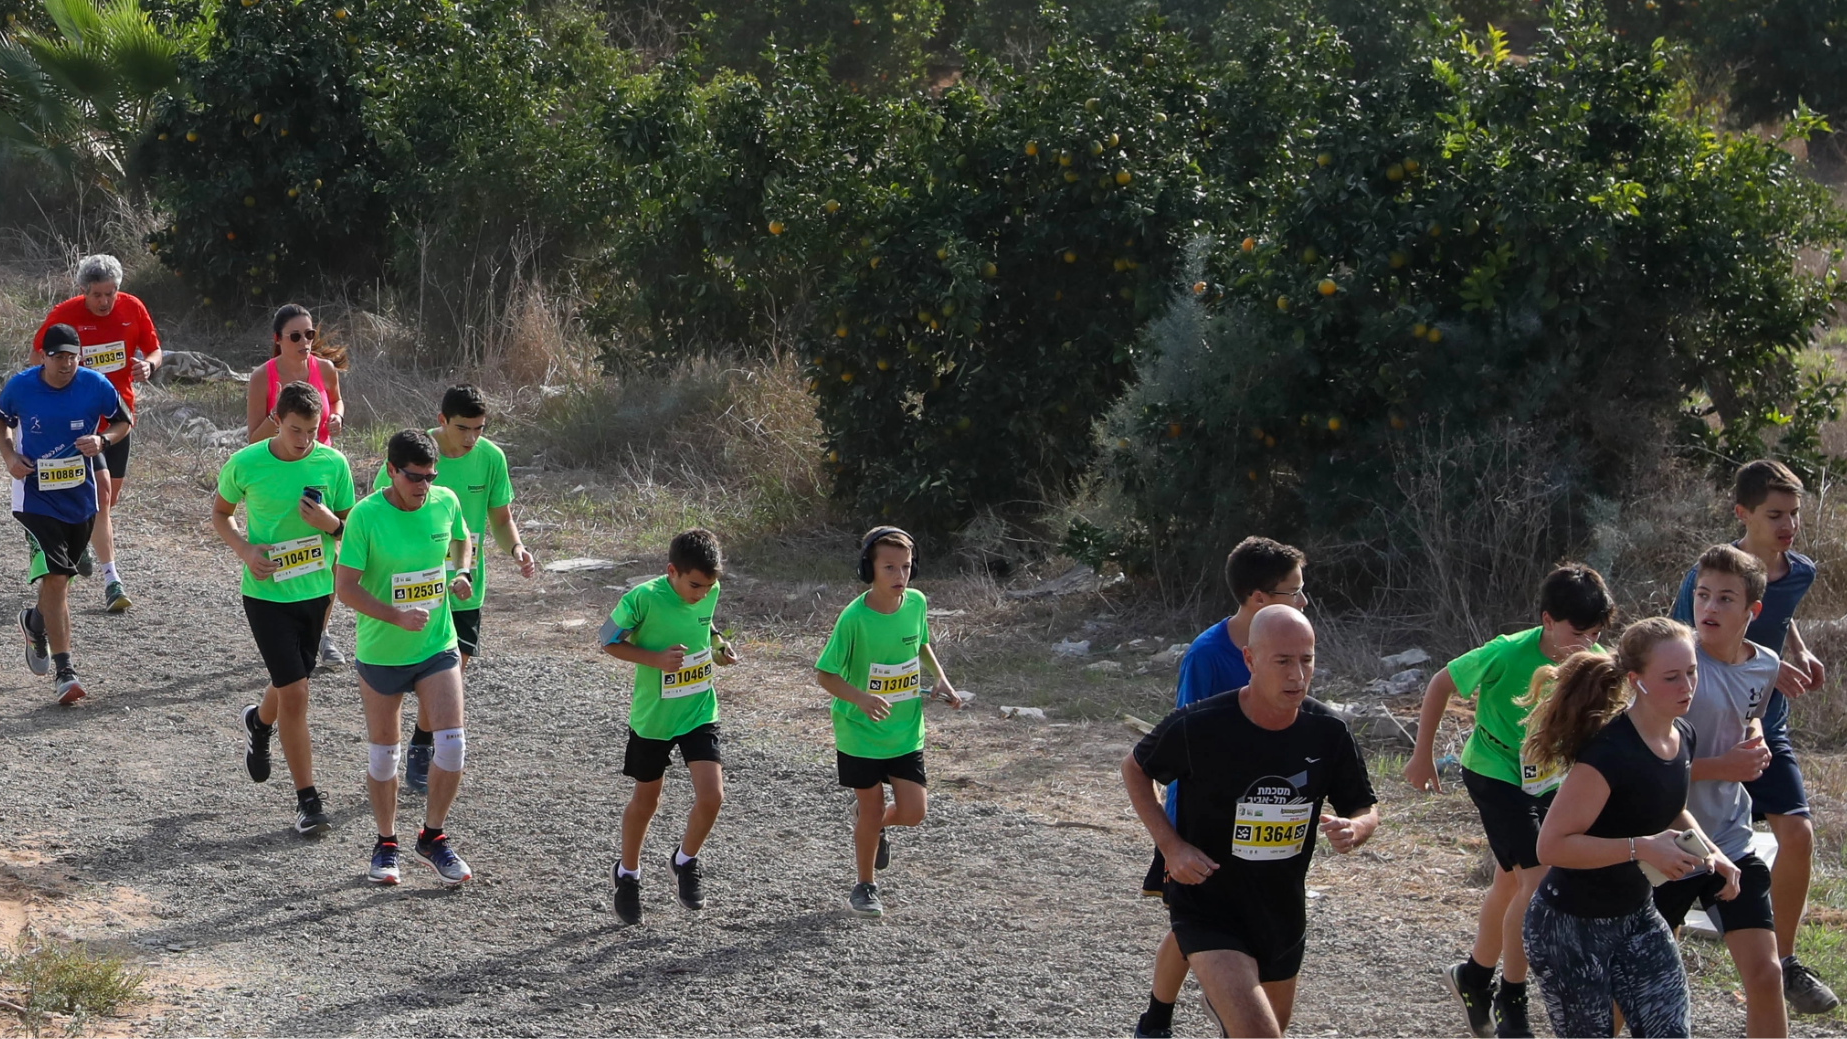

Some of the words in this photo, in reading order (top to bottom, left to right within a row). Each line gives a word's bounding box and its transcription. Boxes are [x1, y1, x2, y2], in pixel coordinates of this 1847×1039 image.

[94, 352, 116, 364] 1033
[50, 469, 74, 480] 1088
[284, 549, 310, 566] 1047
[407, 584, 434, 599] 1253
[677, 667, 704, 684] 1046
[884, 676, 910, 691] 1310
[1256, 786, 1291, 796] מסכמת
[1254, 825, 1293, 842] 1364
